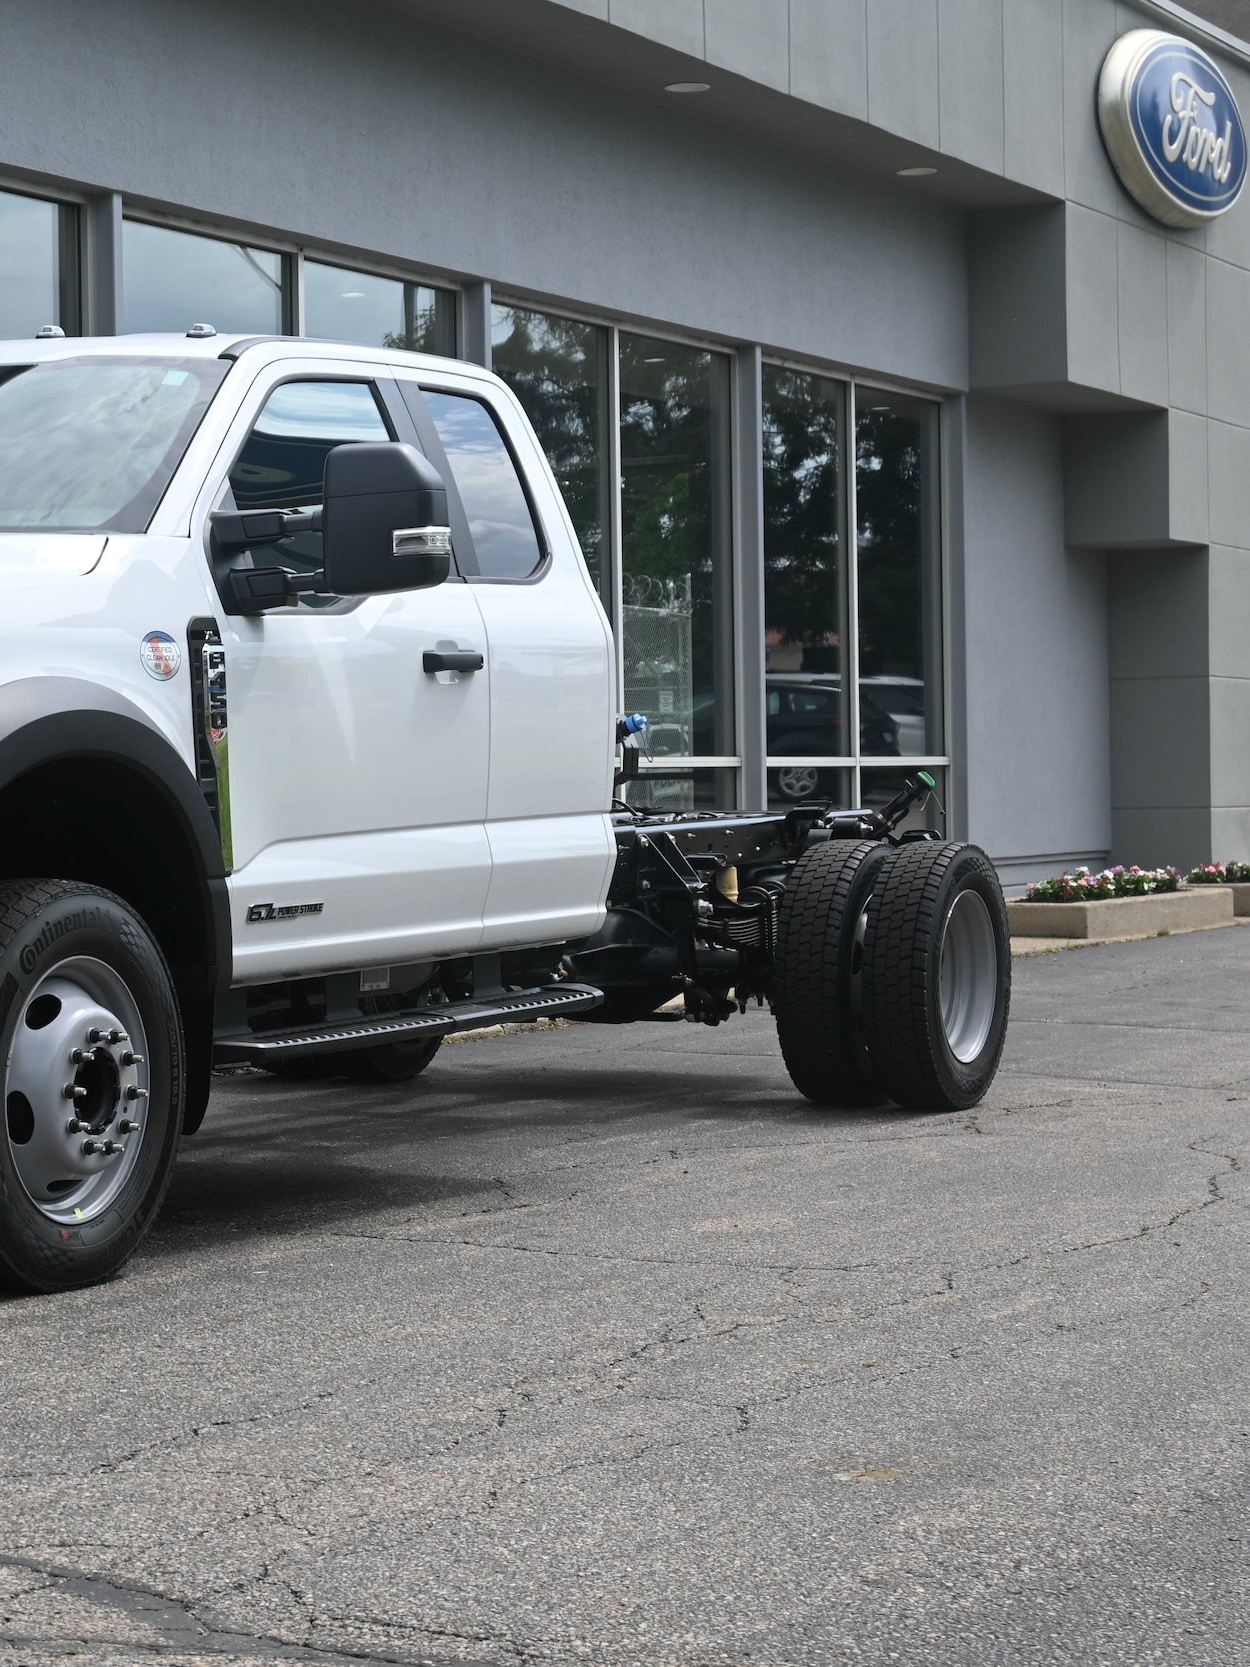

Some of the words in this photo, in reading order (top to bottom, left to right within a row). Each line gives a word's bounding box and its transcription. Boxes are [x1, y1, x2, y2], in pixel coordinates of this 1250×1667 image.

[1162, 72, 1232, 184] Ford
[19, 906, 102, 975] Continental
[277, 905, 299, 916] POWER
[299, 902, 324, 914] STROKE
